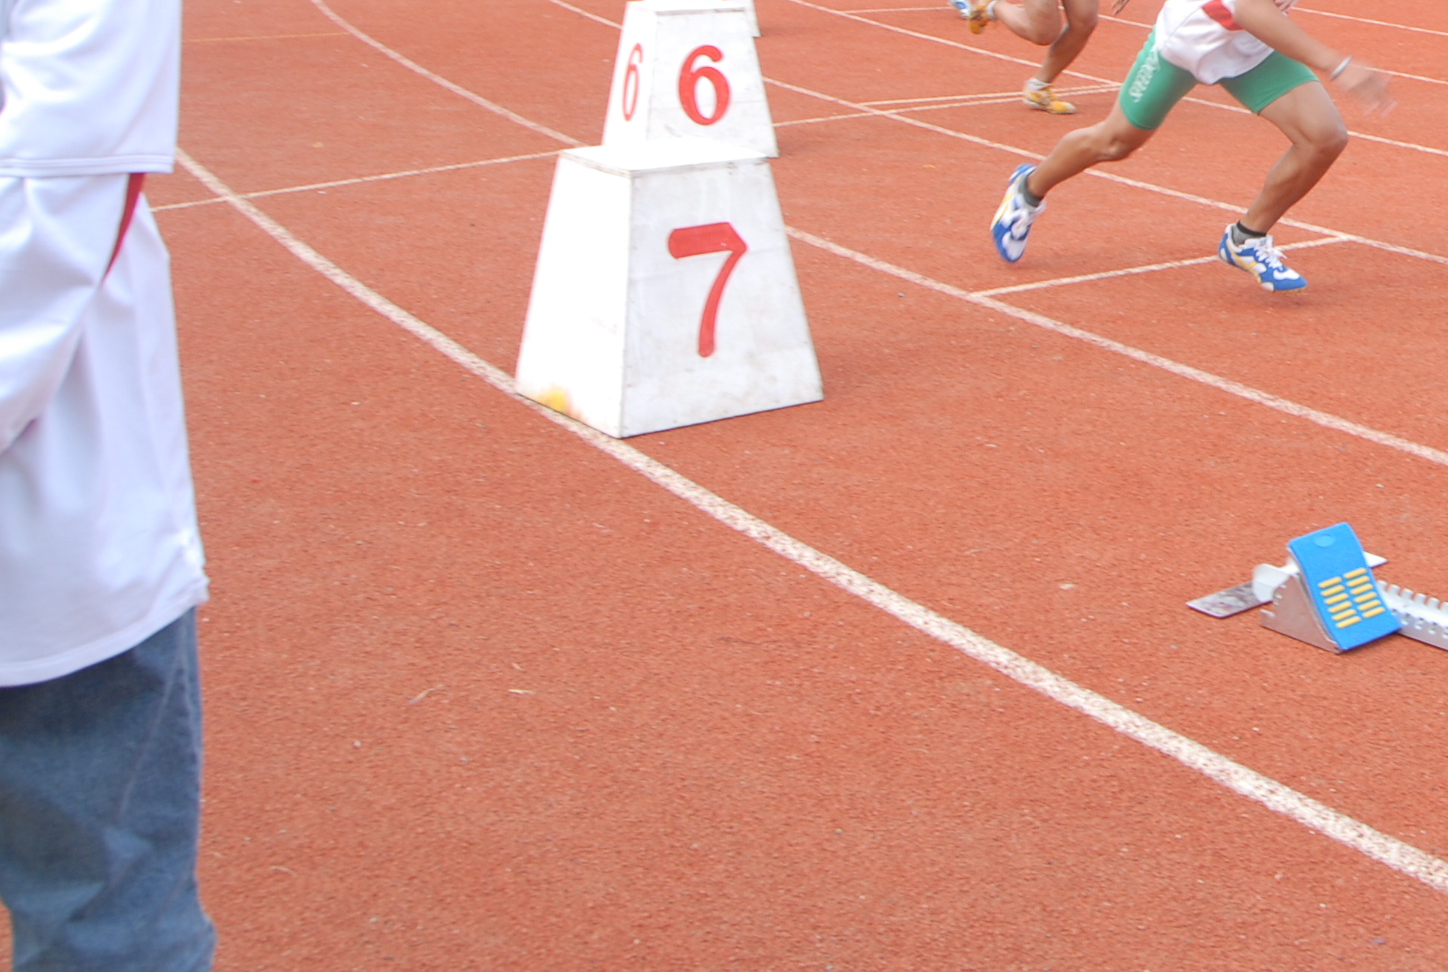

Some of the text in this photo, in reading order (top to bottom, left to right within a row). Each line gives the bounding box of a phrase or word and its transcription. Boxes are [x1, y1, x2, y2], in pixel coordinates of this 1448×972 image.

[622, 42, 643, 122] 6
[677, 45, 731, 126] 6
[667, 222, 748, 358] 7
